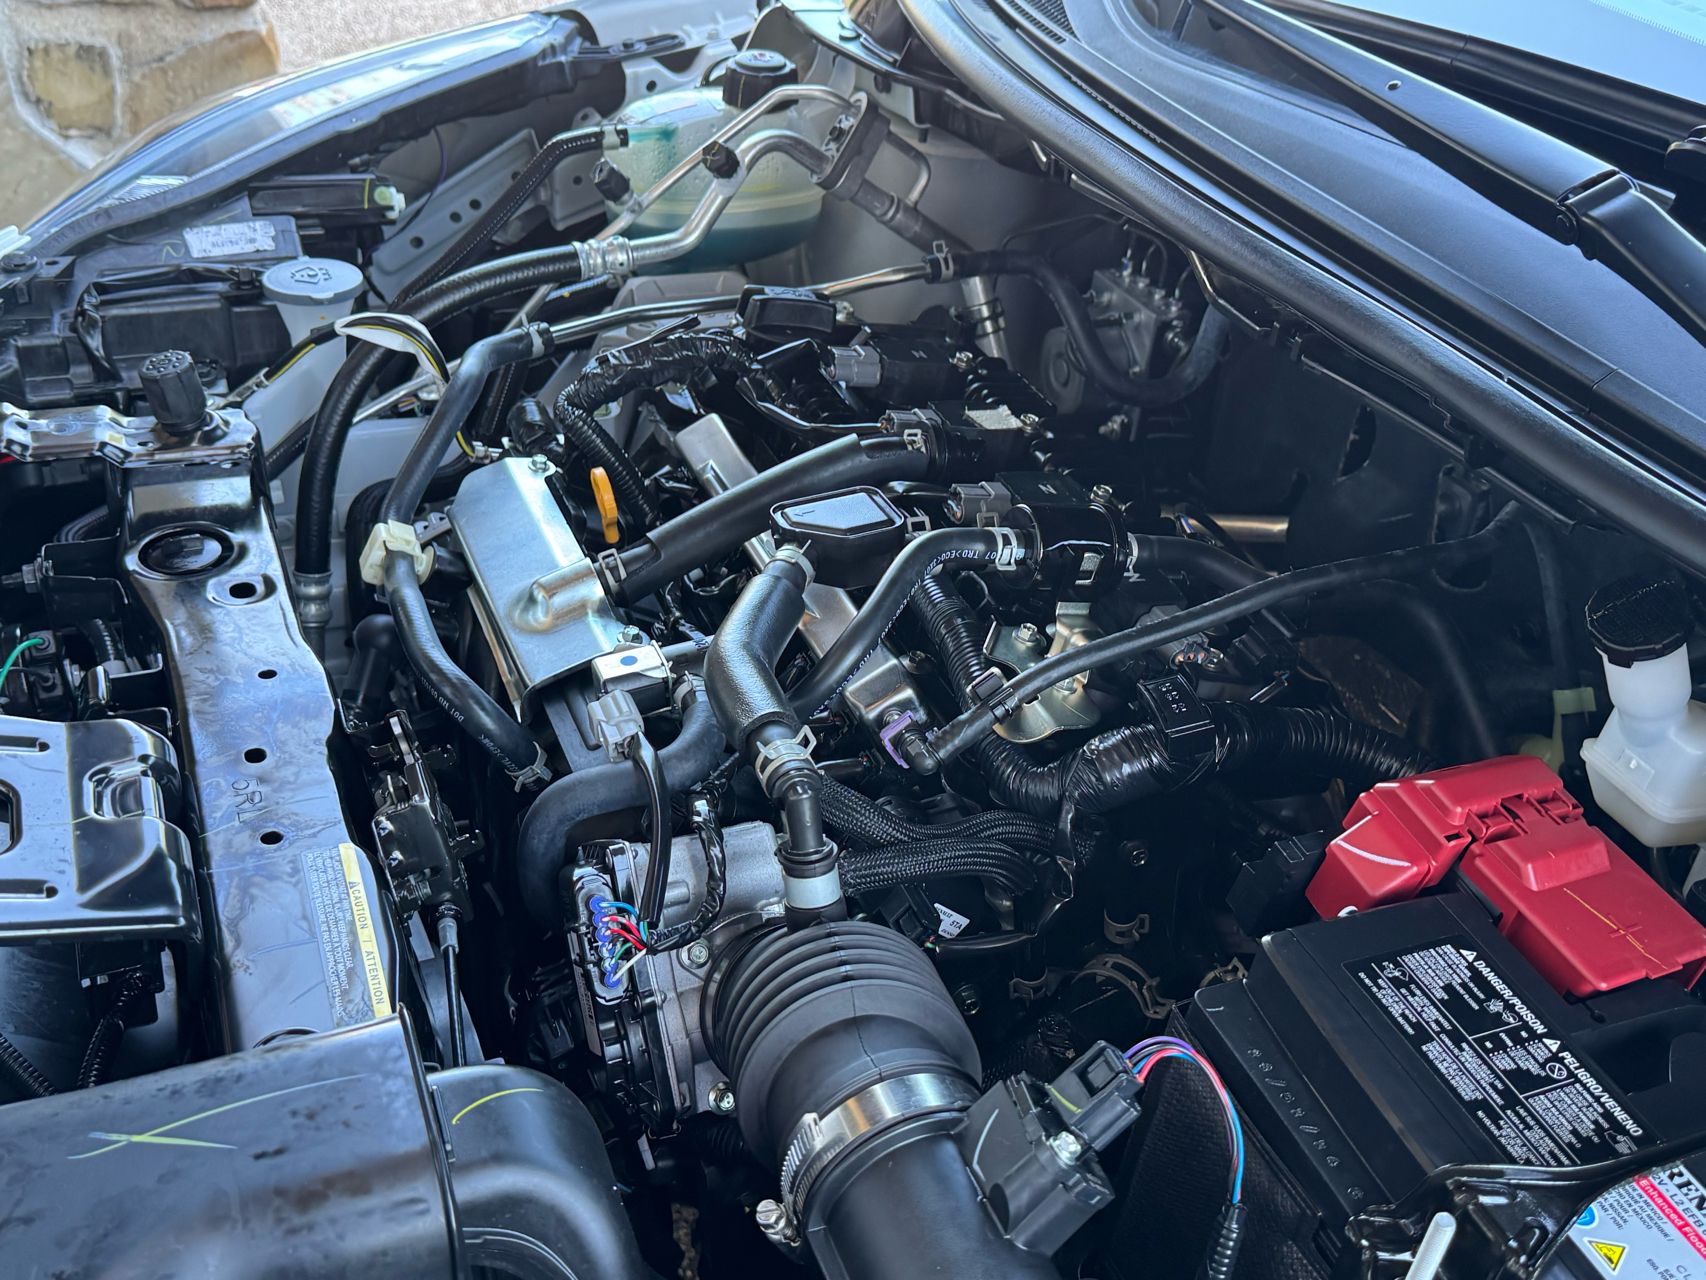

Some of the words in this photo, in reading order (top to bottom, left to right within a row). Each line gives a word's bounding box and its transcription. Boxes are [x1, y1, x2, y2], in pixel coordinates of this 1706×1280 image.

[351, 888, 368, 930] CAUTION
[364, 949, 384, 1004] ATTENTION
[1472, 959, 1548, 1034] DANGER/POISON
[1557, 1050, 1644, 1136] PELIGRO/VENENO
[1639, 1179, 1683, 1228] Enhanced
[1667, 1167, 1706, 1218] REN
[1670, 1193, 1684, 1207] L2
[1682, 1207, 1704, 1228] EFB
